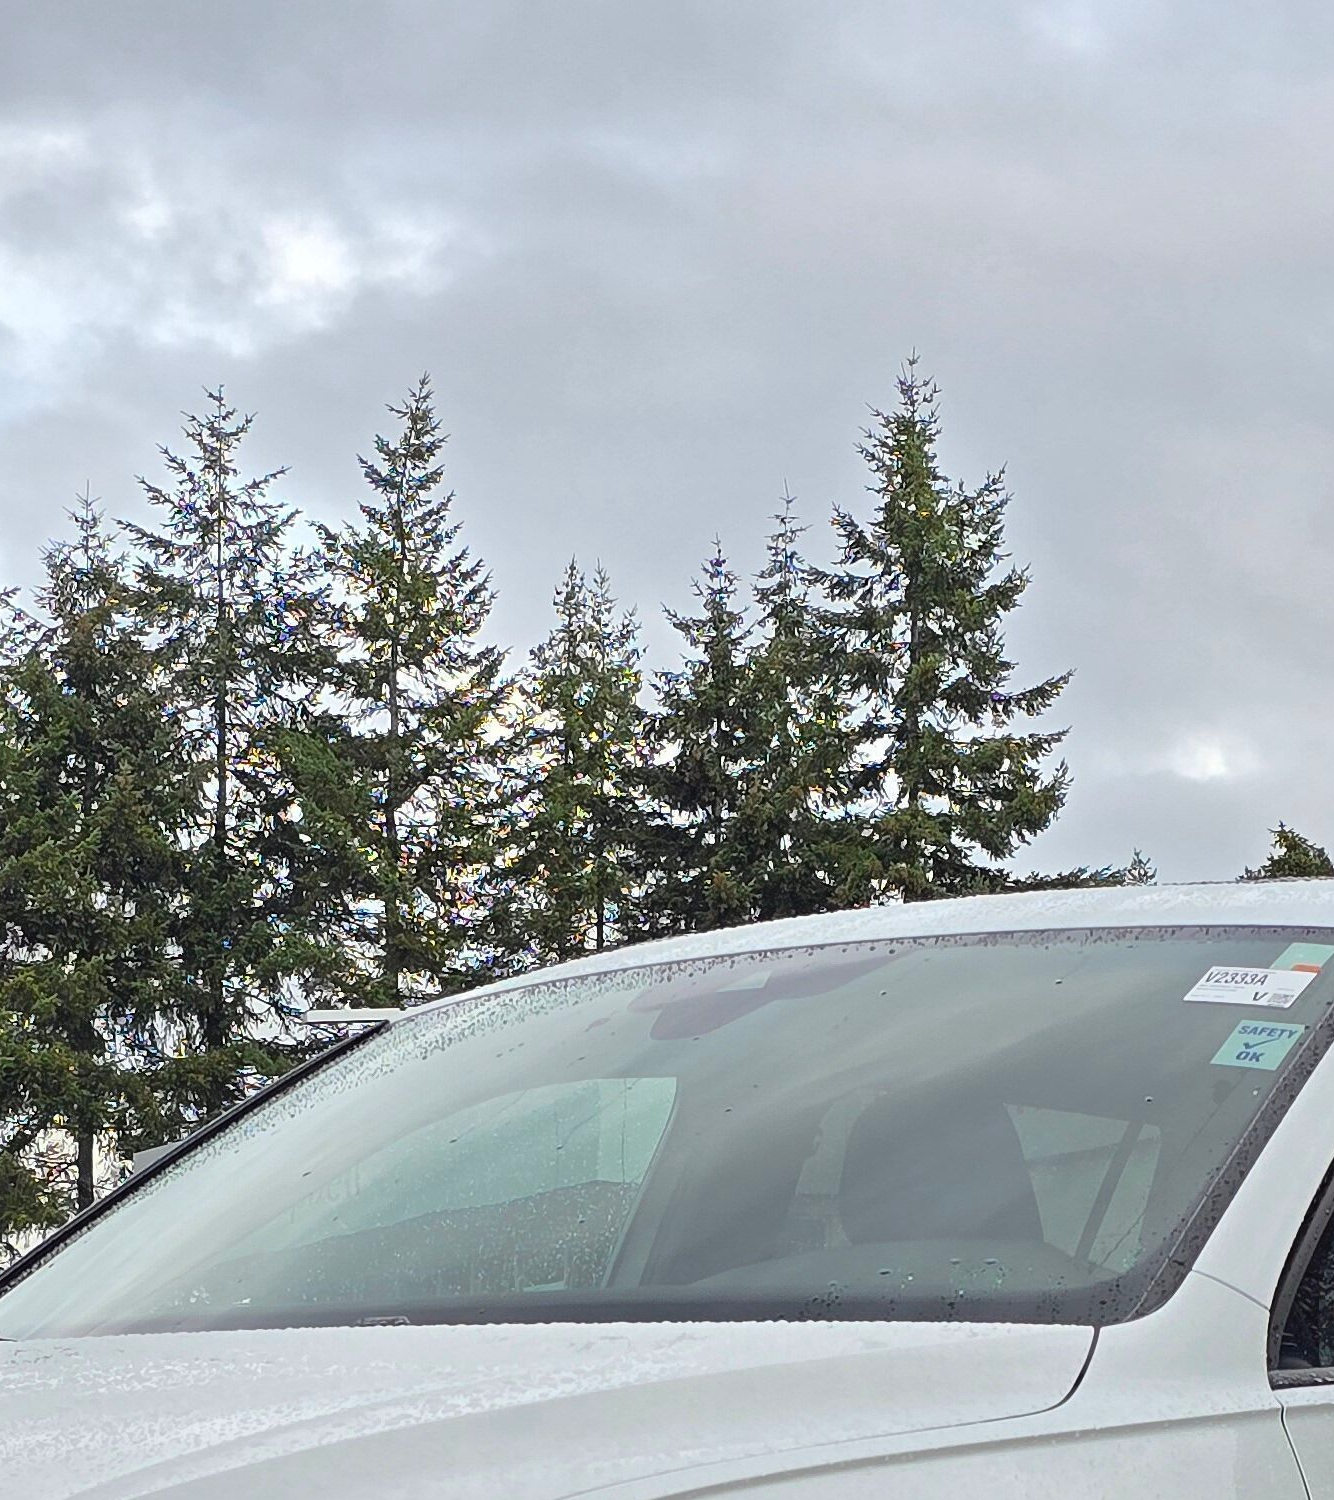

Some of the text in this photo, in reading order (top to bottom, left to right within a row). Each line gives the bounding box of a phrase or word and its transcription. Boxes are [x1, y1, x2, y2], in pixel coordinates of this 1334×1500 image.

[1205, 971, 1269, 986] V2333A
[1238, 1025, 1298, 1039] SAFETY
[1235, 1051, 1265, 1063] OK
